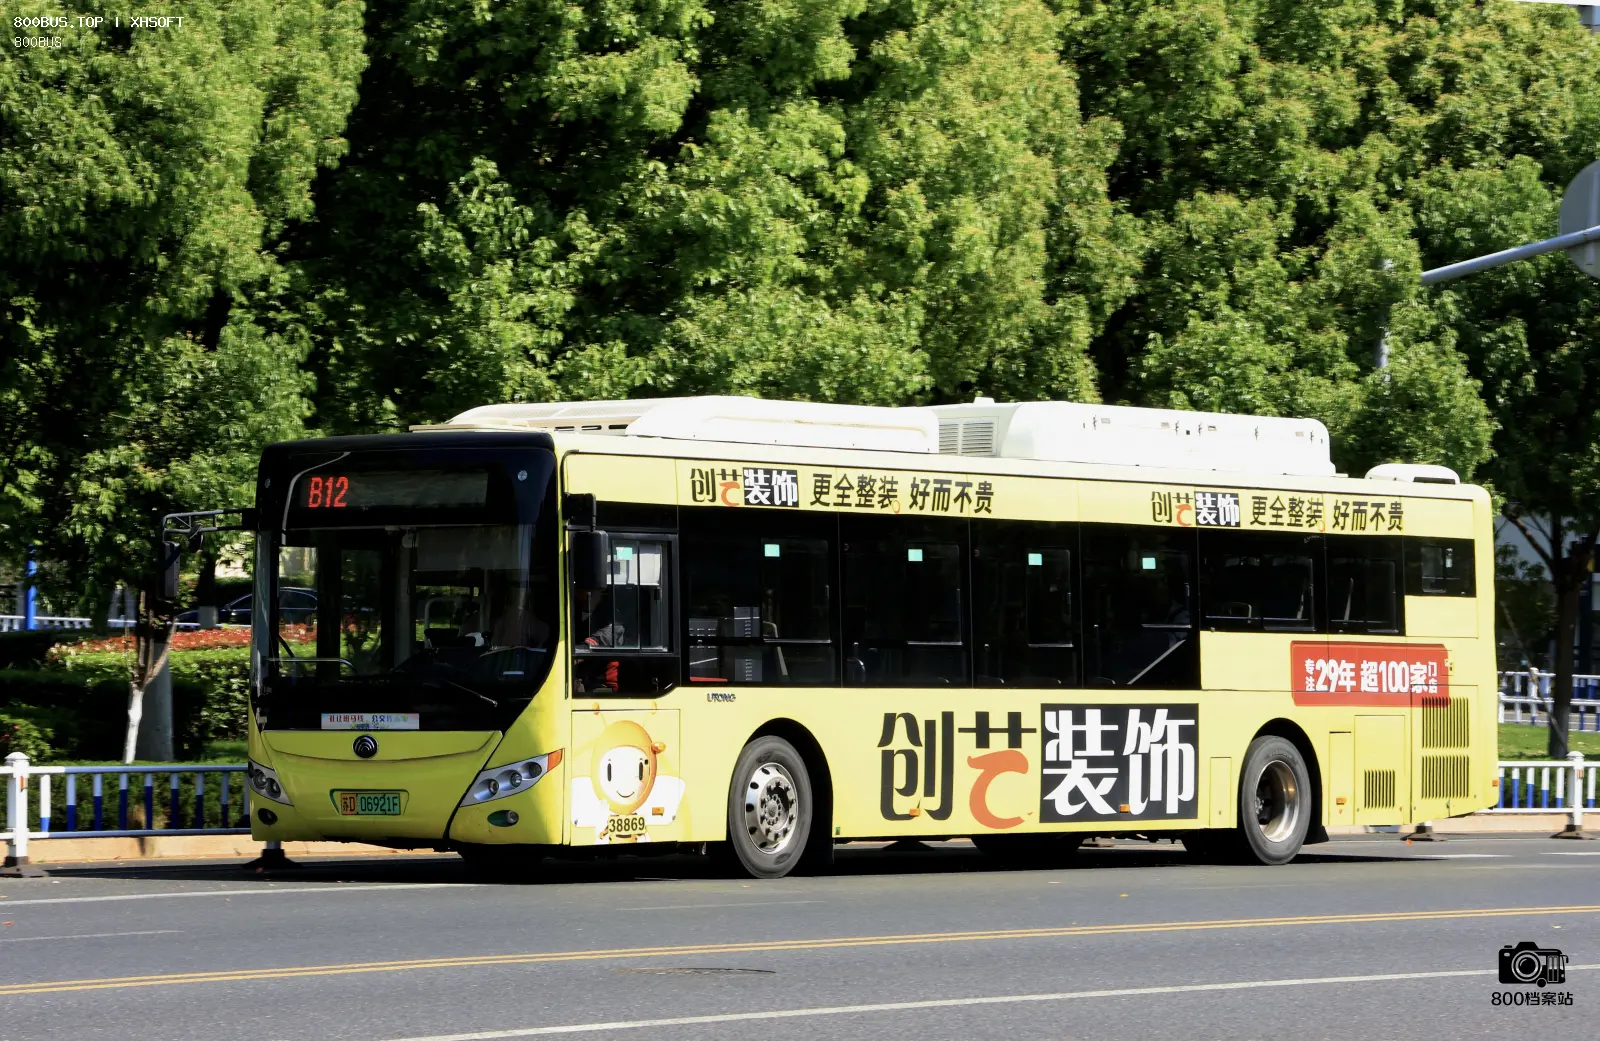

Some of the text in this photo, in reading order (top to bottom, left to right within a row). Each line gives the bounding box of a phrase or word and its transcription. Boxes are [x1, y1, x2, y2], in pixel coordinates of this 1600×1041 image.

[308, 476, 349, 508] B12
[690, 467, 799, 508] 创艺装饰
[908, 476, 995, 515] 好而不贵
[1151, 490, 1241, 527] 创艺装饰
[1332, 499, 1404, 532] 好而不贵
[877, 706, 1199, 829] 创艺装饰
[609, 816, 645, 833] 38869
